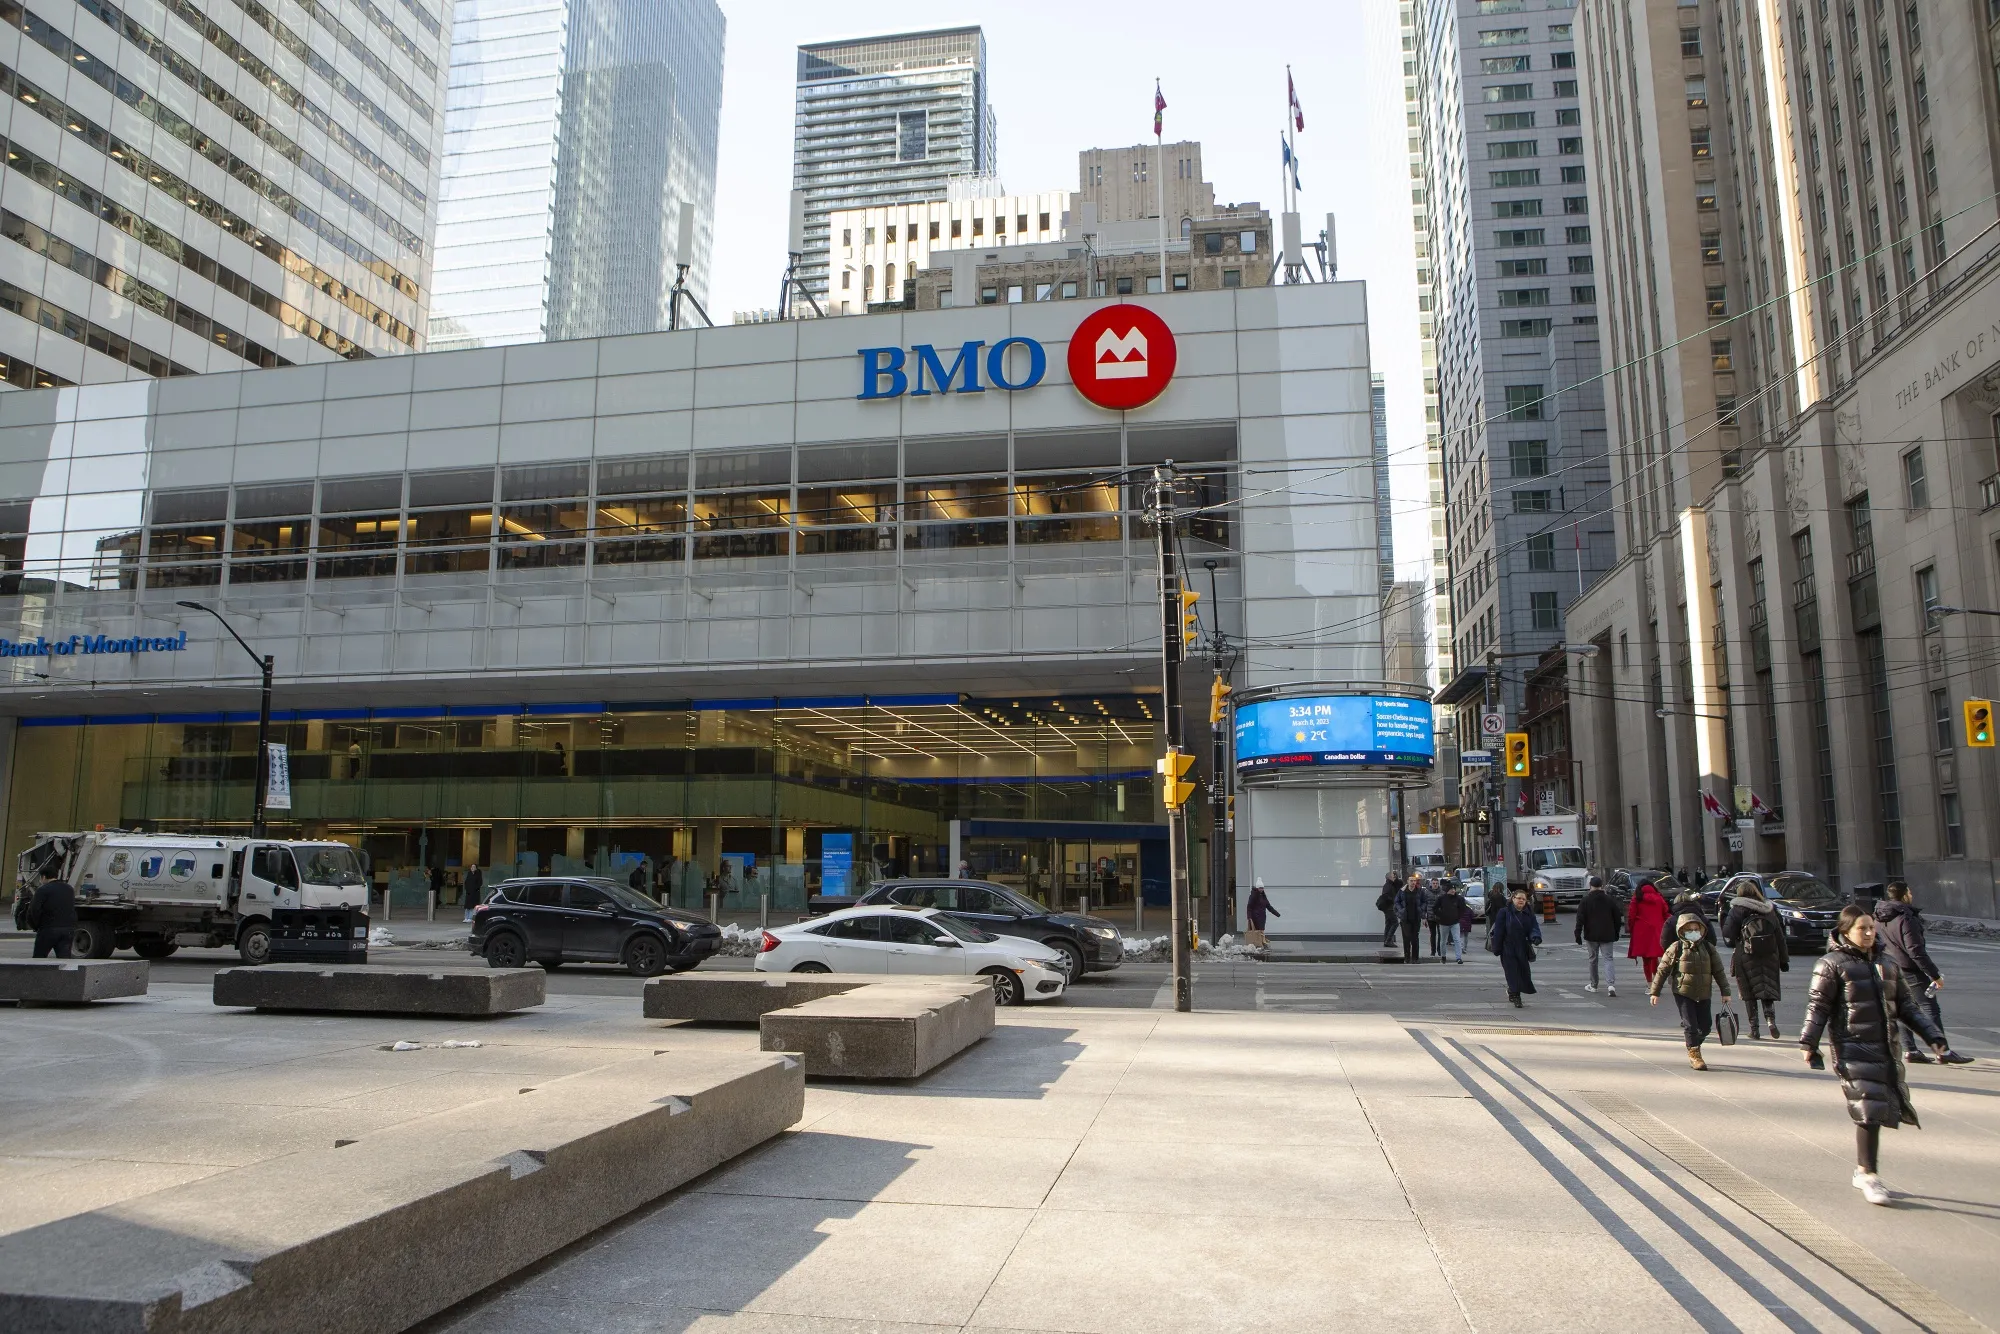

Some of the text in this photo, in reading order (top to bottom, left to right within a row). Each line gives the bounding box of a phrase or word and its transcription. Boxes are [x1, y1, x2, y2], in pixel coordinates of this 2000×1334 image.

[857, 337, 1046, 400] BMO
[1895, 381, 1919, 409] THE
[1924, 351, 1961, 390] BANK
[1966, 333, 1984, 358] OF
[0, 630, 187, 657] Bank of Montreal
[1289, 705, 1331, 717] 3:34 PM
[1311, 730, 1327, 740] 2°C
[1532, 826, 1562, 836] FedEx
[1731, 840, 1742, 849] 40
